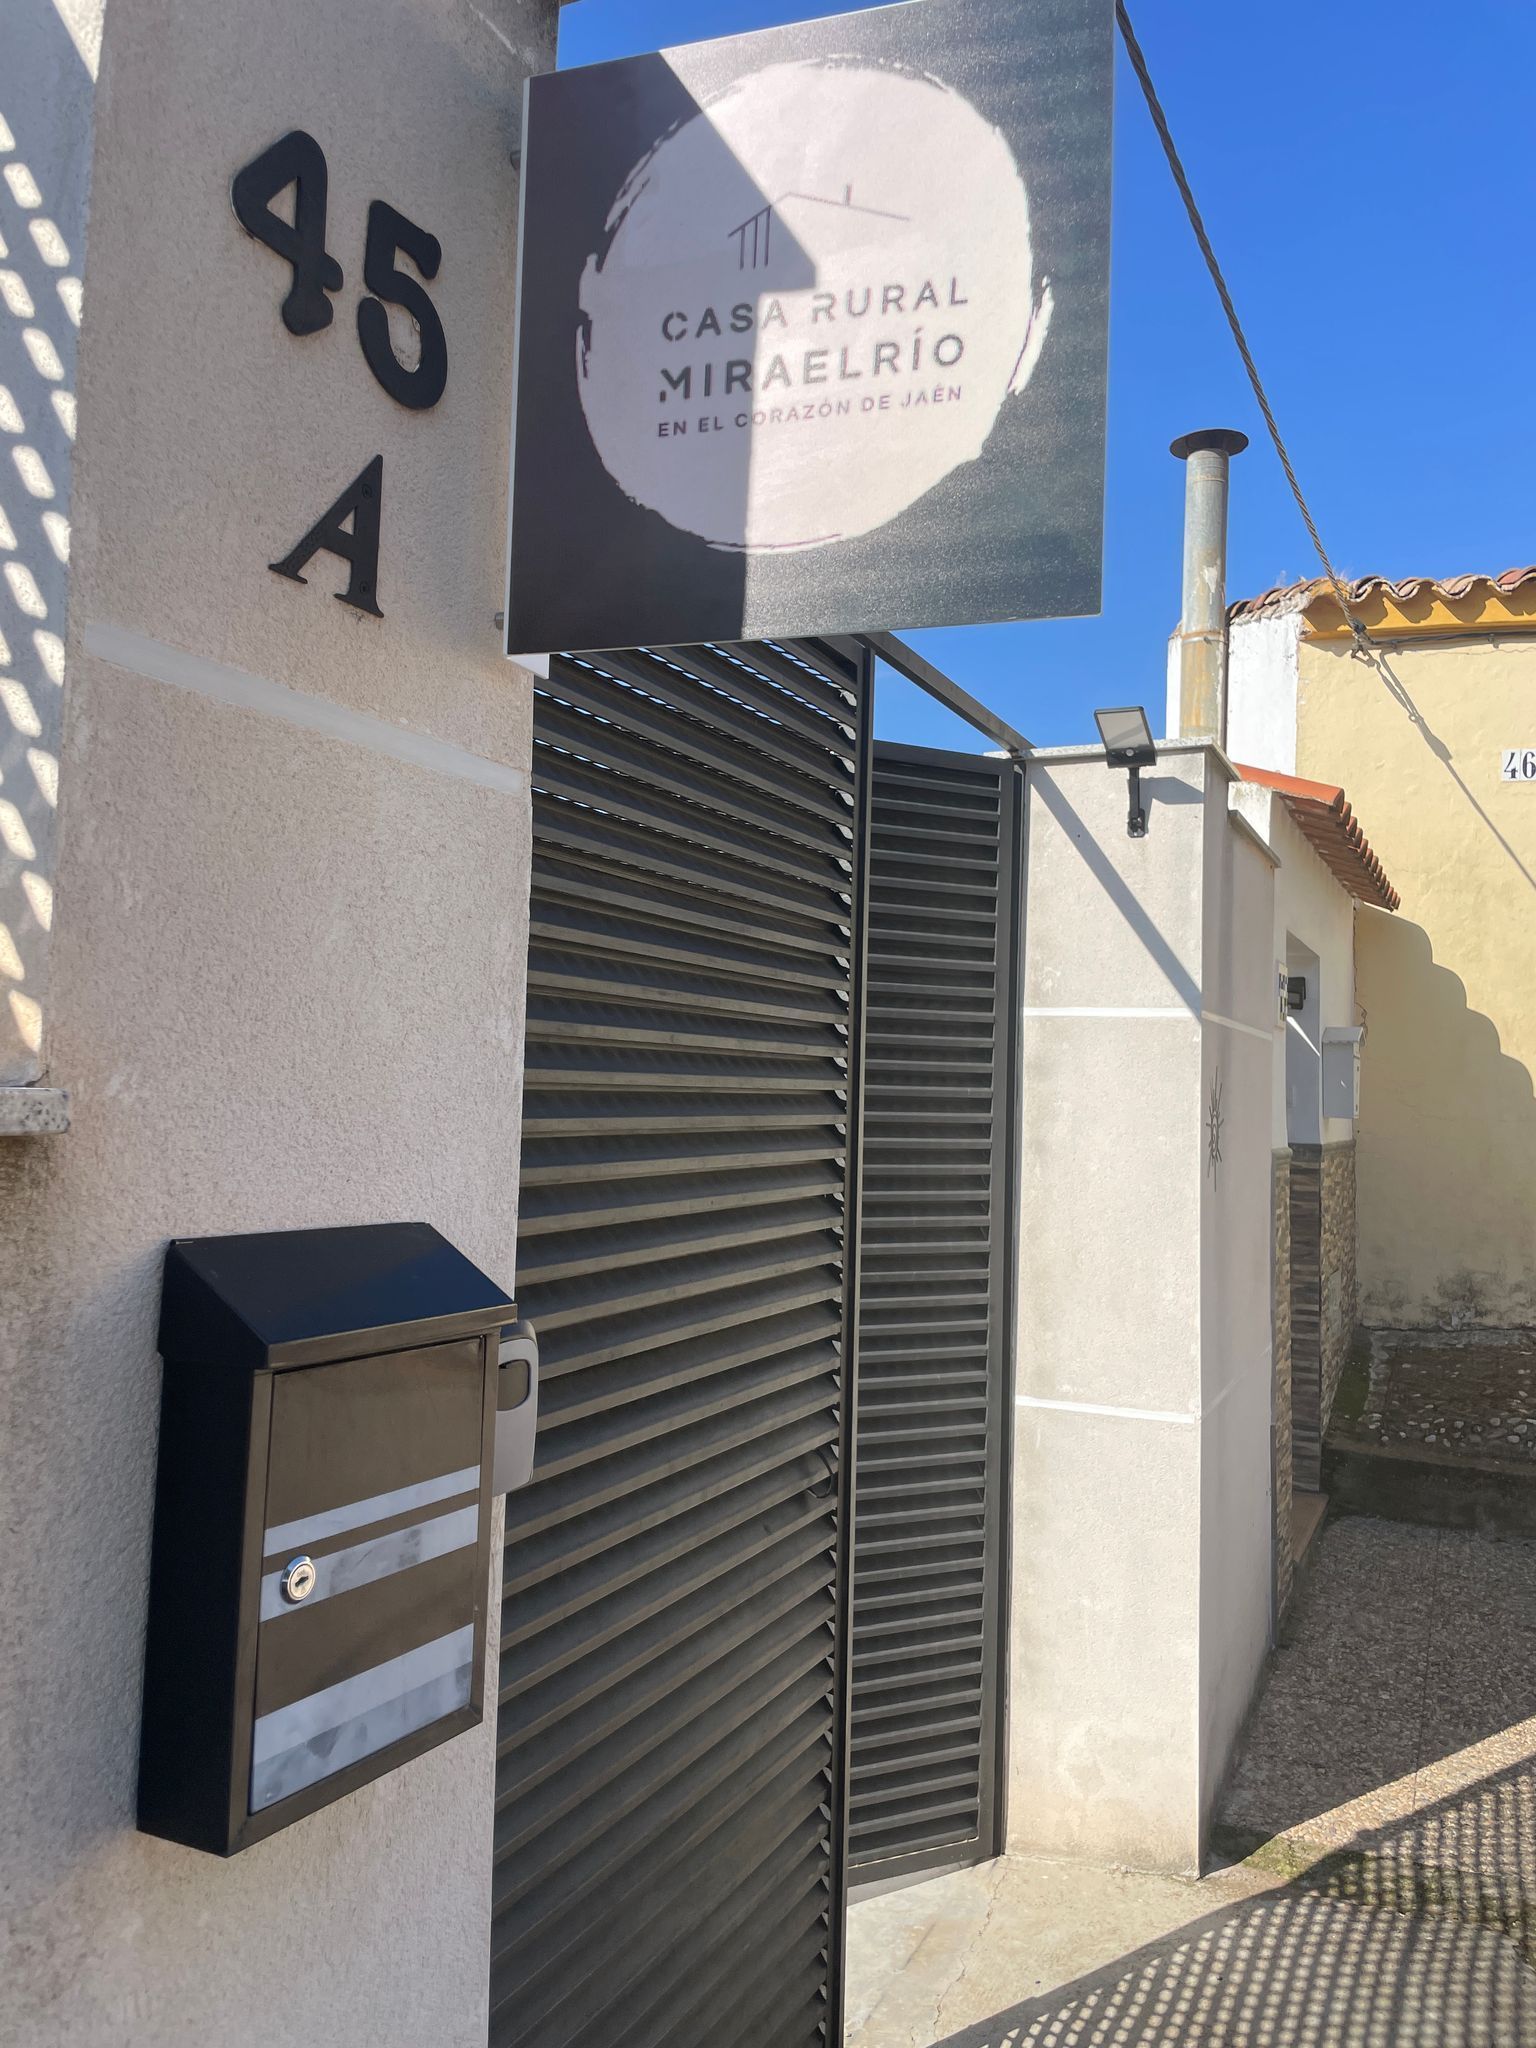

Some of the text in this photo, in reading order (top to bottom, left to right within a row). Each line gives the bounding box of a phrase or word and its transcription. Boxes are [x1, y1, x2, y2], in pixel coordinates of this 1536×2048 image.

[232, 130, 448, 409] 45
[661, 276, 968, 341] CASA RURAL
[660, 327, 964, 403] MIRAELRÍO
[657, 384, 961, 437] EN EL CORAZÓN DE JAÉN
[268, 454, 384, 618] A
[1504, 751, 1536, 779] 46
